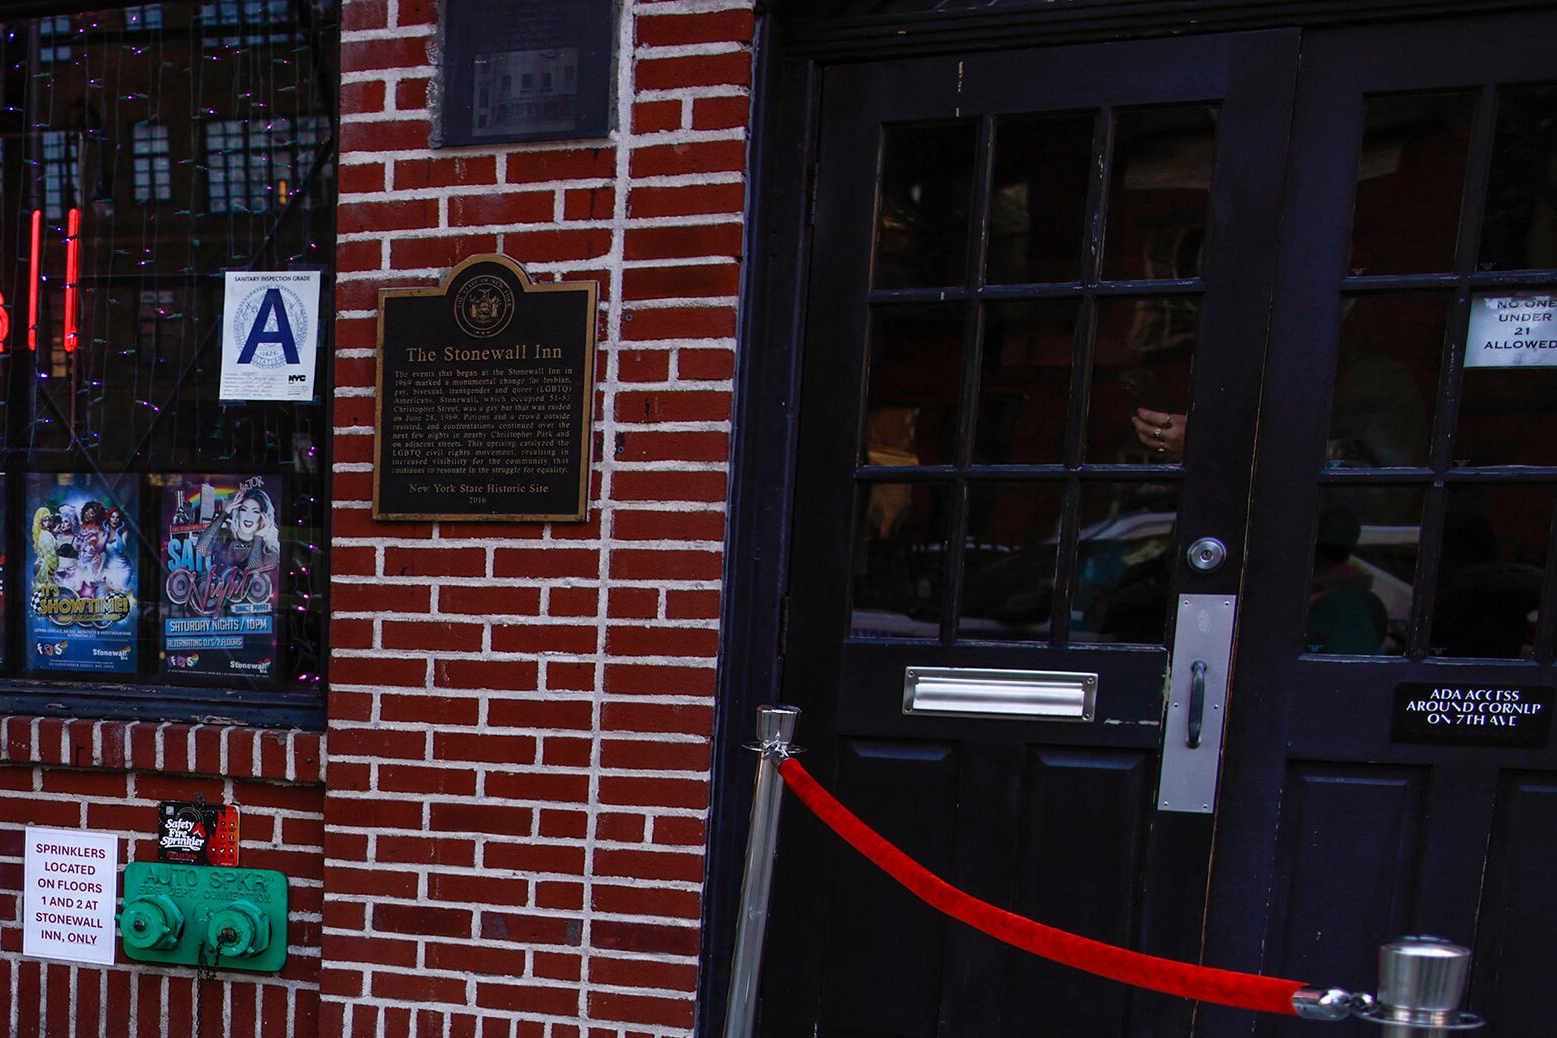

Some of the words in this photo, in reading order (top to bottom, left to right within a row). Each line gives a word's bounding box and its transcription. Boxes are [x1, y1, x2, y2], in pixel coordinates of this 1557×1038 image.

[1499, 313, 1552, 322] UNDER
[237, 288, 301, 364] A
[1514, 327, 1530, 335] 21
[1483, 340, 1557, 350] ALLOWED
[406, 347, 437, 362] The
[444, 344, 527, 362] Stonewall
[535, 344, 563, 359] Inn
[456, 369, 477, 378] began
[507, 368, 544, 376] Stonewall
[499, 378, 525, 386] change
[449, 387, 491, 396] transgender
[518, 413, 540, 421] crowd
[498, 422, 534, 430] continued
[490, 431, 533, 439] Christopher
[505, 457, 549, 465] community
[410, 484, 429, 493] New
[434, 484, 455, 492] York
[459, 484, 483, 492] State
[487, 484, 525, 492] Historic
[529, 484, 549, 492] Site
[41, 583, 60, 597] IT'S
[39, 598, 129, 615] SHOWTIME!
[170, 618, 210, 632] SATURDAY
[211, 618, 239, 631] NIGHTS
[246, 618, 267, 631] 10PM
[166, 639, 204, 649] ALTERNATING
[222, 638, 243, 648] FLOORS
[1429, 688, 1461, 700] ADA
[165, 818, 195, 832] Safety
[169, 828, 188, 838] Fire
[160, 835, 205, 852] Sprinkler
[36, 843, 106, 859] SPRINKLERS
[45, 862, 95, 875] LOCATED
[145, 866, 199, 887] AUTO
[38, 878, 55, 889] ON
[58, 880, 102, 893] FLOORS
[139, 883, 163, 896] FIRE
[203, 890, 272, 904] CONNECTION
[41, 896, 46, 905] 1
[49, 897, 73, 908] AND
[77, 900, 82, 909] 2
[85, 900, 98, 910] AT
[35, 912, 103, 928] STONEWALL
[41, 930, 65, 943] INN,
[68, 933, 97, 944] ONLY
